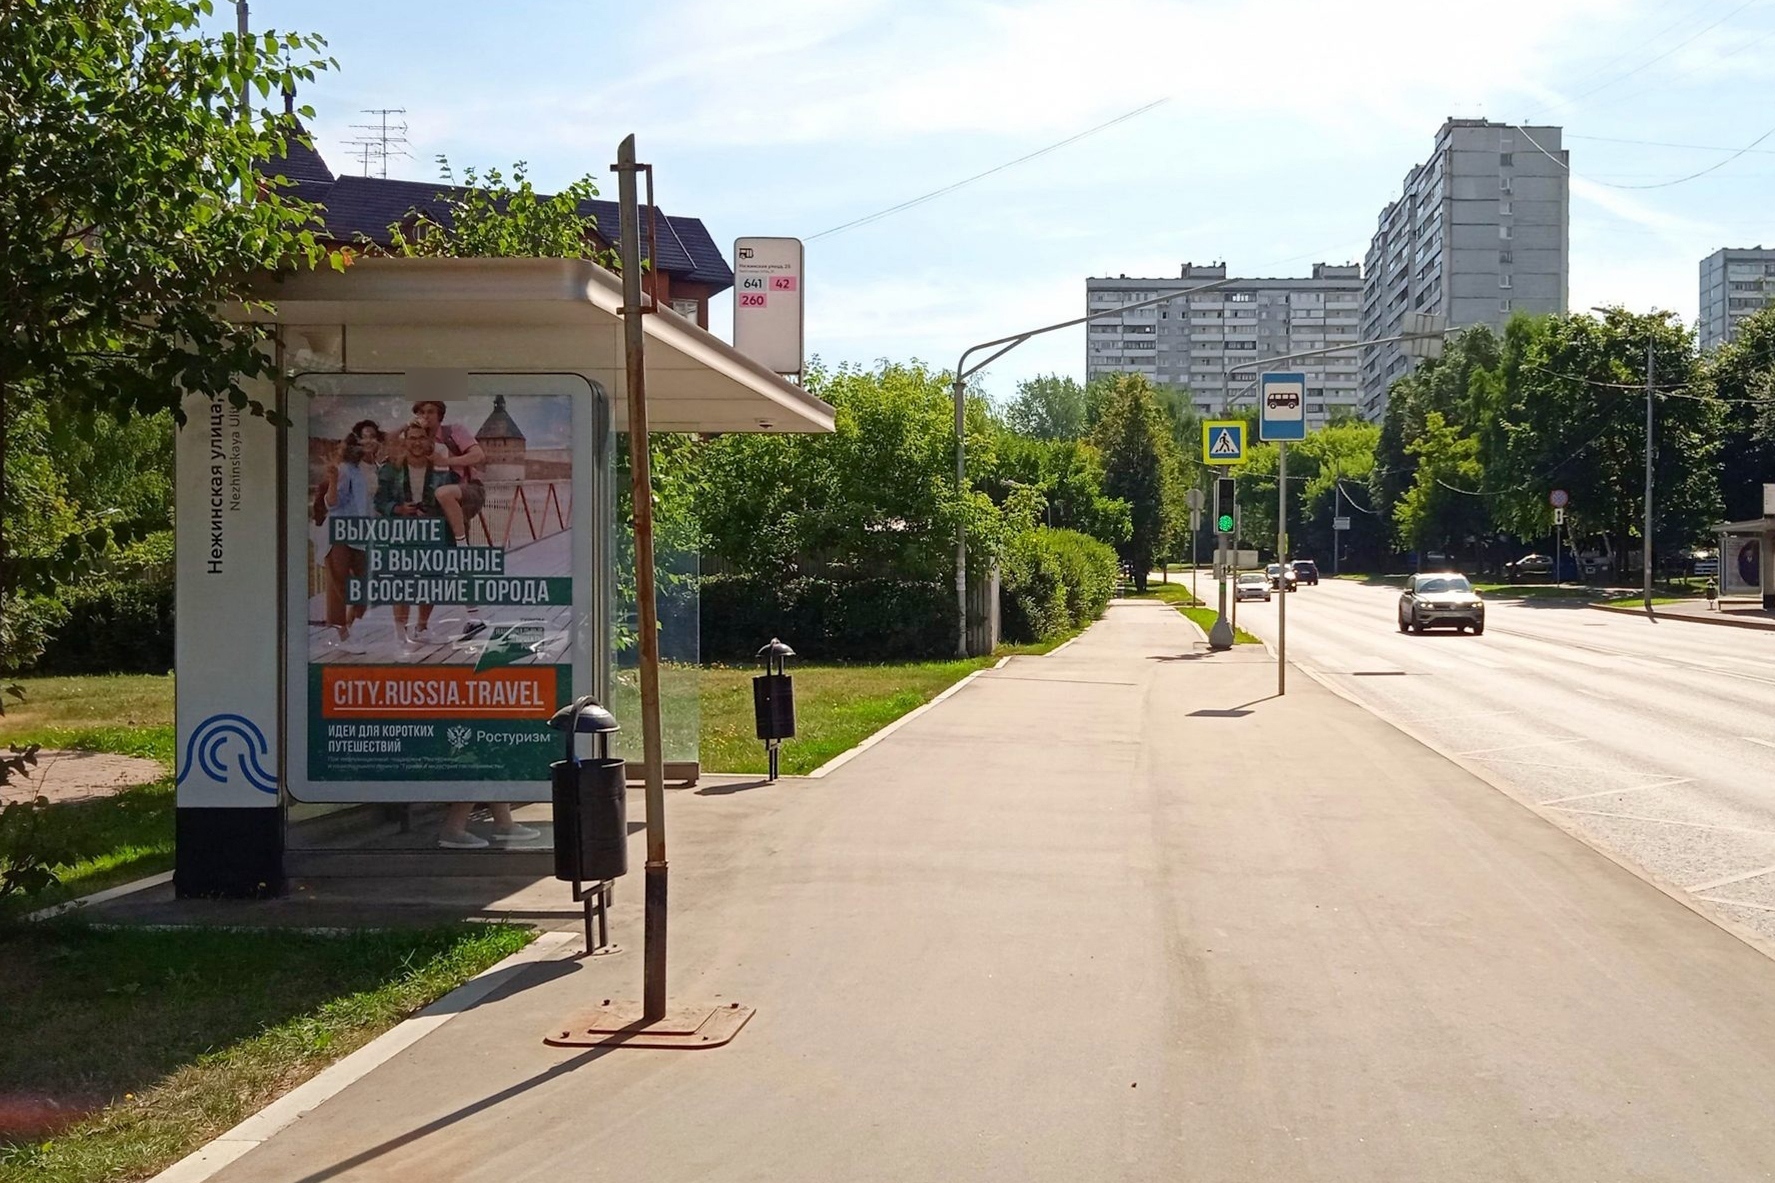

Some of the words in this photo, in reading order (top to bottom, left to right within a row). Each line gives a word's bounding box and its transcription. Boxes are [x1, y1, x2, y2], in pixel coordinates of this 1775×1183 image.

[744, 279, 762, 288] 641
[776, 279, 790, 289] 42
[742, 295, 764, 305] 260
[210, 398, 226, 460] улица,
[229, 432, 242, 511] Nezhinskaya
[207, 464, 223, 574] Нежинская
[334, 519, 441, 543] ВЫХОДИТЕ
[370, 549, 382, 571] В
[388, 549, 502, 574] ВЫХОДНЫЕ
[350, 579, 361, 601] В
[367, 579, 468, 603] СОСЕДНИЕ
[474, 579, 550, 603] ГОРОДА
[333, 680, 545, 705] CITY.RUSSIA.TRAVEL
[328, 724, 356, 738] ИДЕИ
[358, 724, 380, 739] ДЛЯ
[382, 724, 434, 738] КОРОТКИХ
[476, 730, 551, 745] Ростуризм
[328, 739, 402, 753] ПУТЕШЕСТВИЙ
